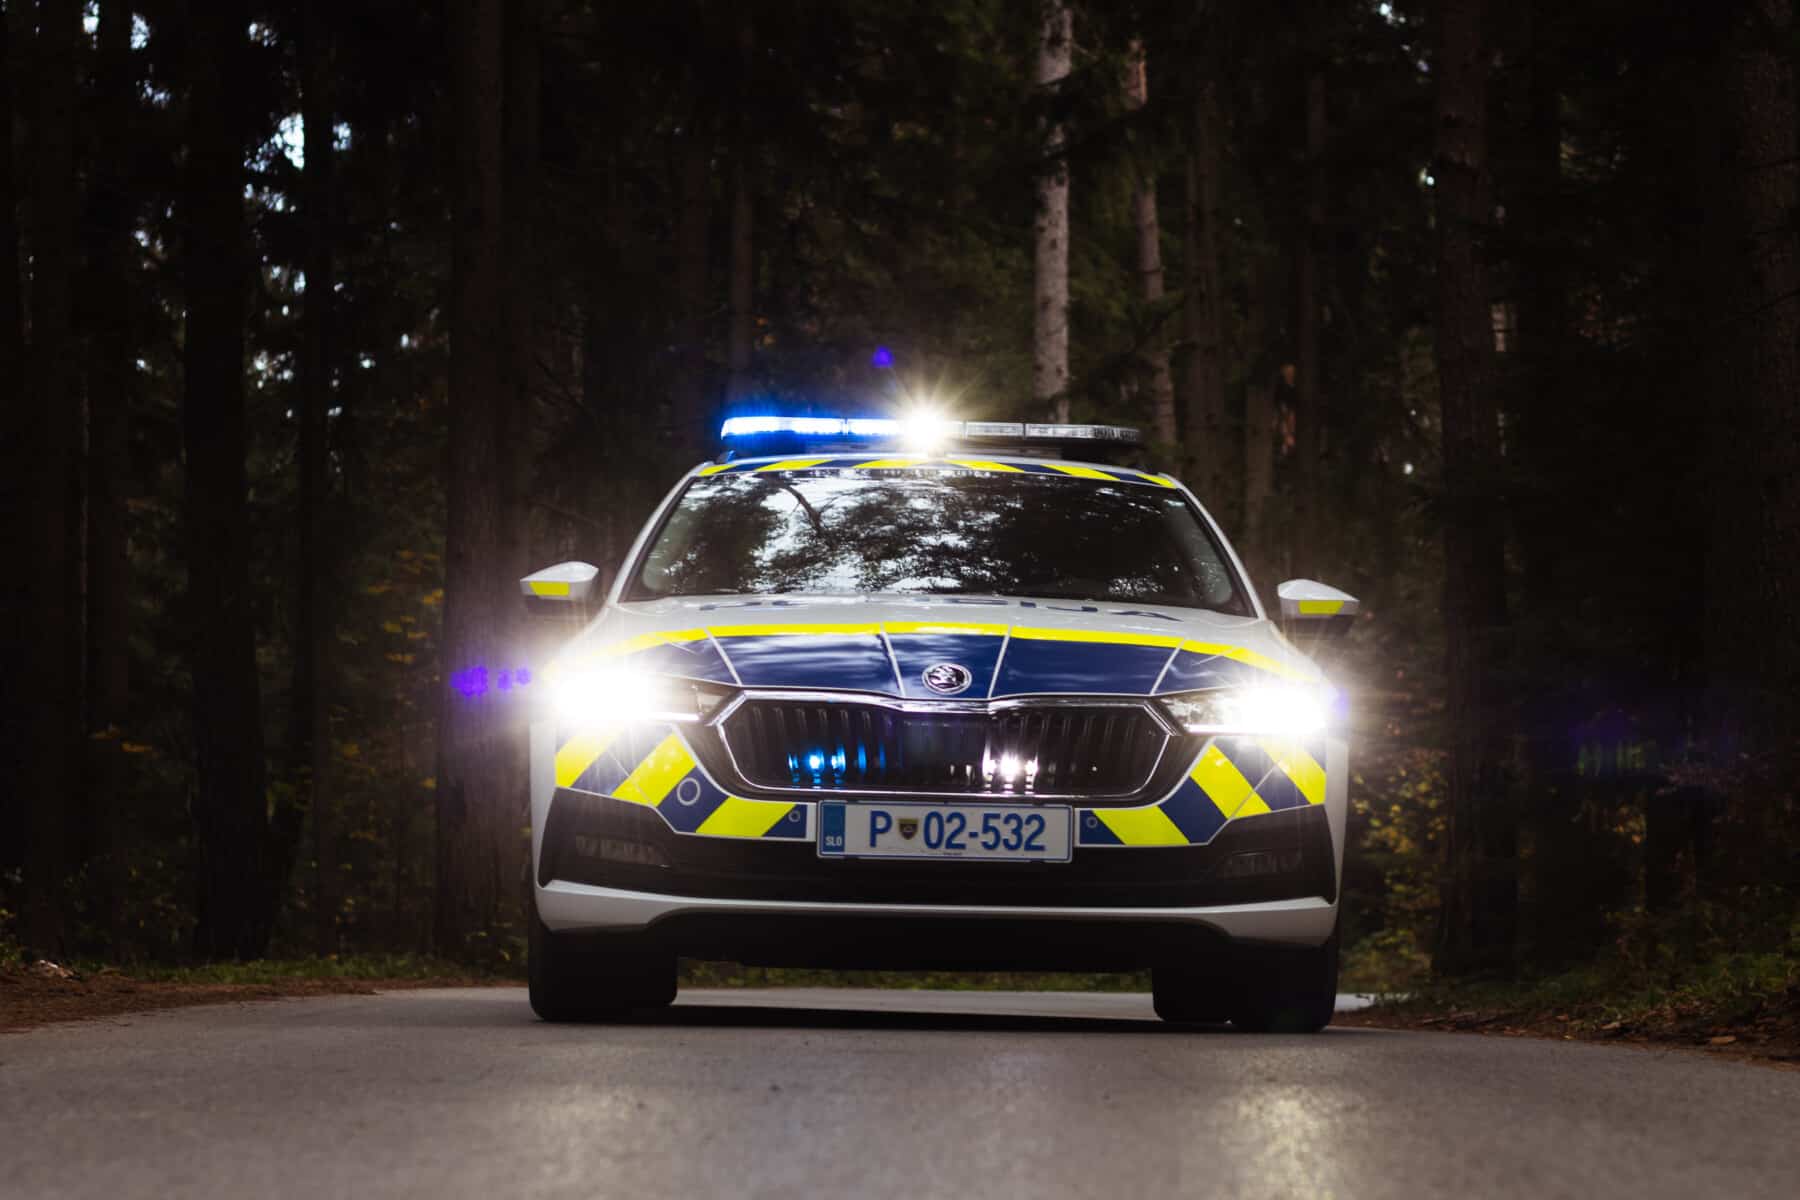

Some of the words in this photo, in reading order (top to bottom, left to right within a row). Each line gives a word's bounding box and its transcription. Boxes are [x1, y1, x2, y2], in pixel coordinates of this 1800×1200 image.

[825, 836, 843, 847] SLO
[869, 810, 892, 848] P
[923, 811, 1046, 851] 02-532
